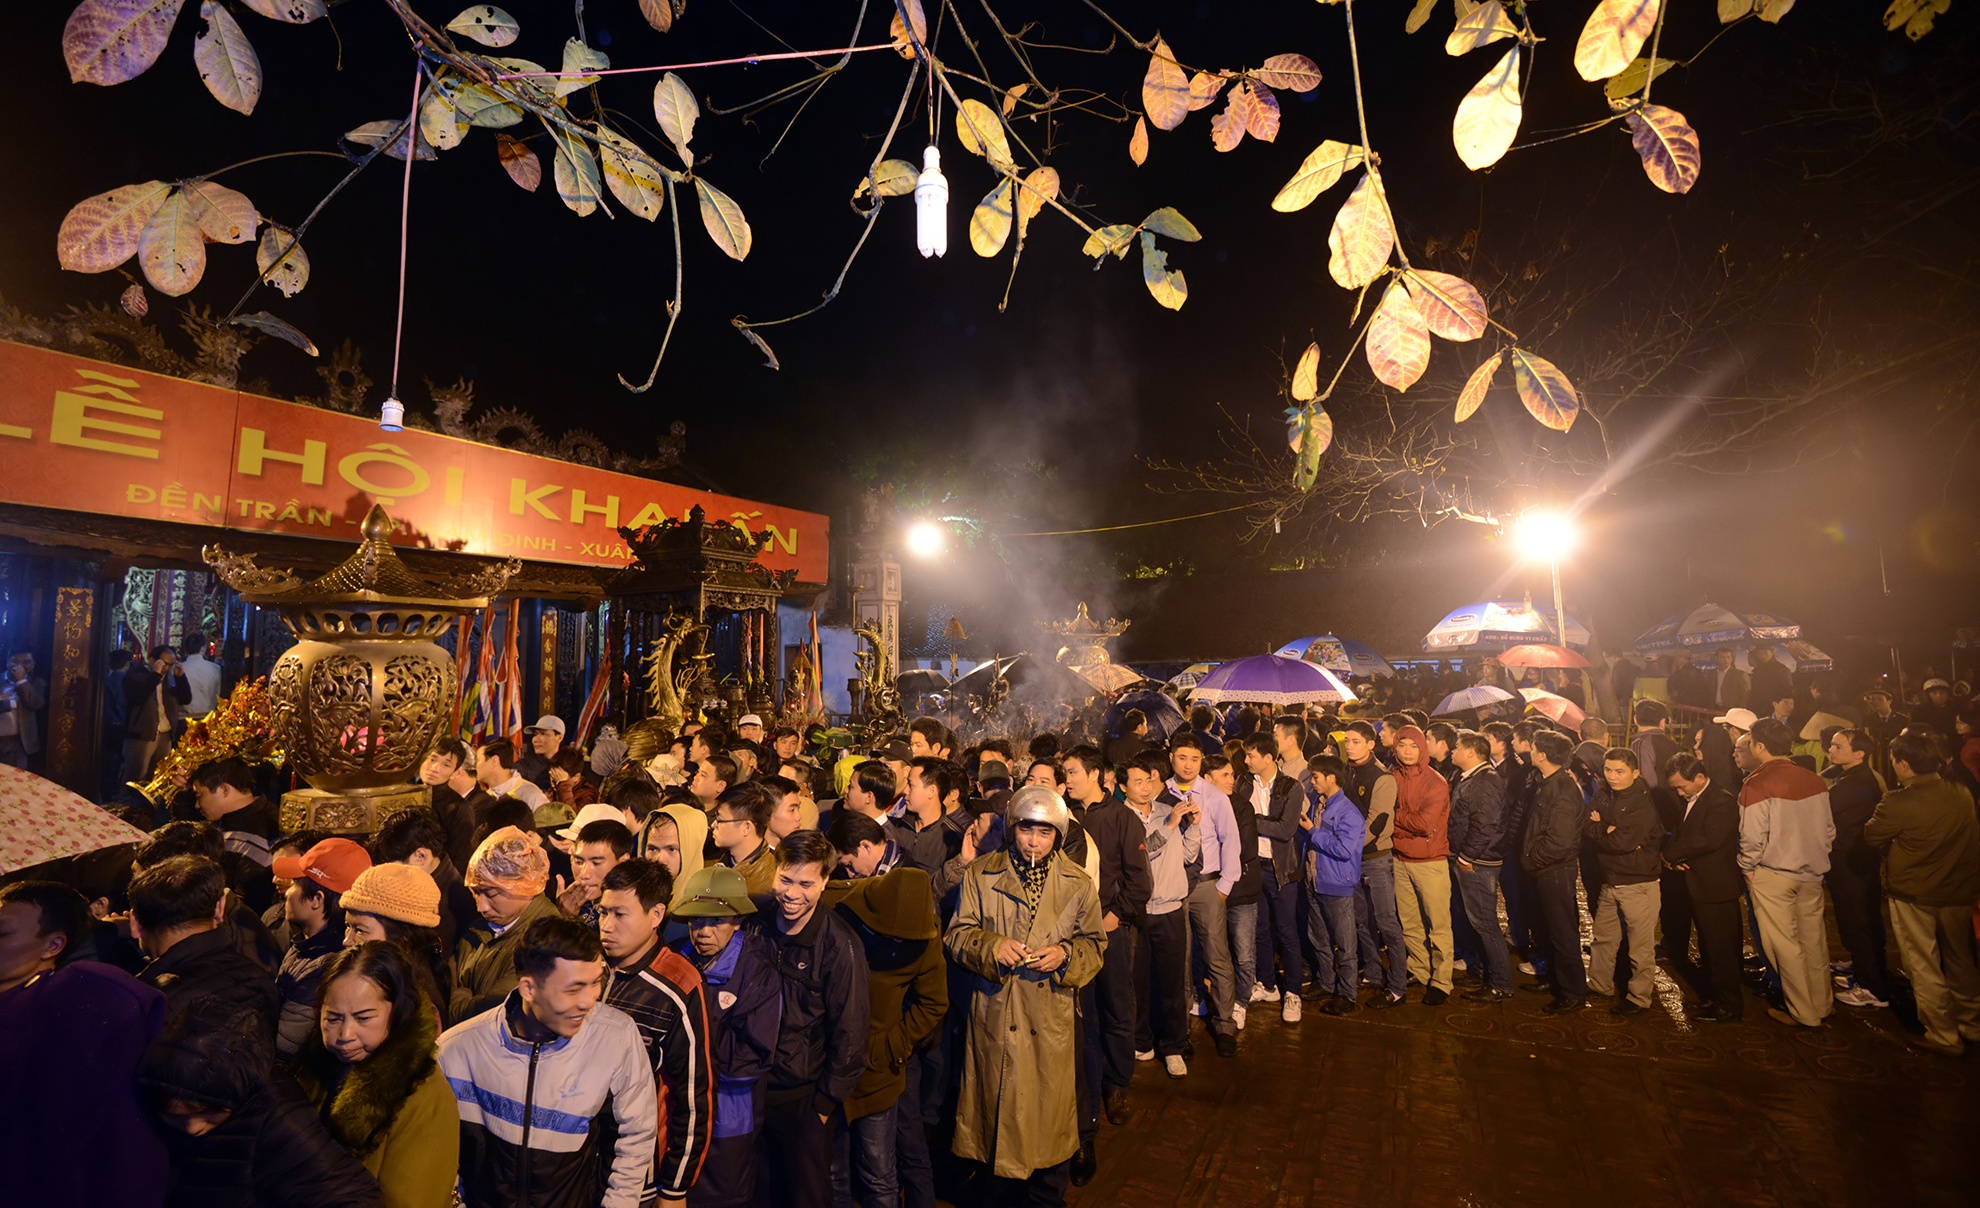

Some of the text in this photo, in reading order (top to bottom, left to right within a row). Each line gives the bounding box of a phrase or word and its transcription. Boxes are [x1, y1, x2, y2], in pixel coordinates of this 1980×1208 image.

[237, 427, 465, 506] HỘI
[126, 481, 222, 513] ĐỀN
[236, 498, 333, 527] TRẦN
[1636, 639, 1674, 650] VIETTEL
